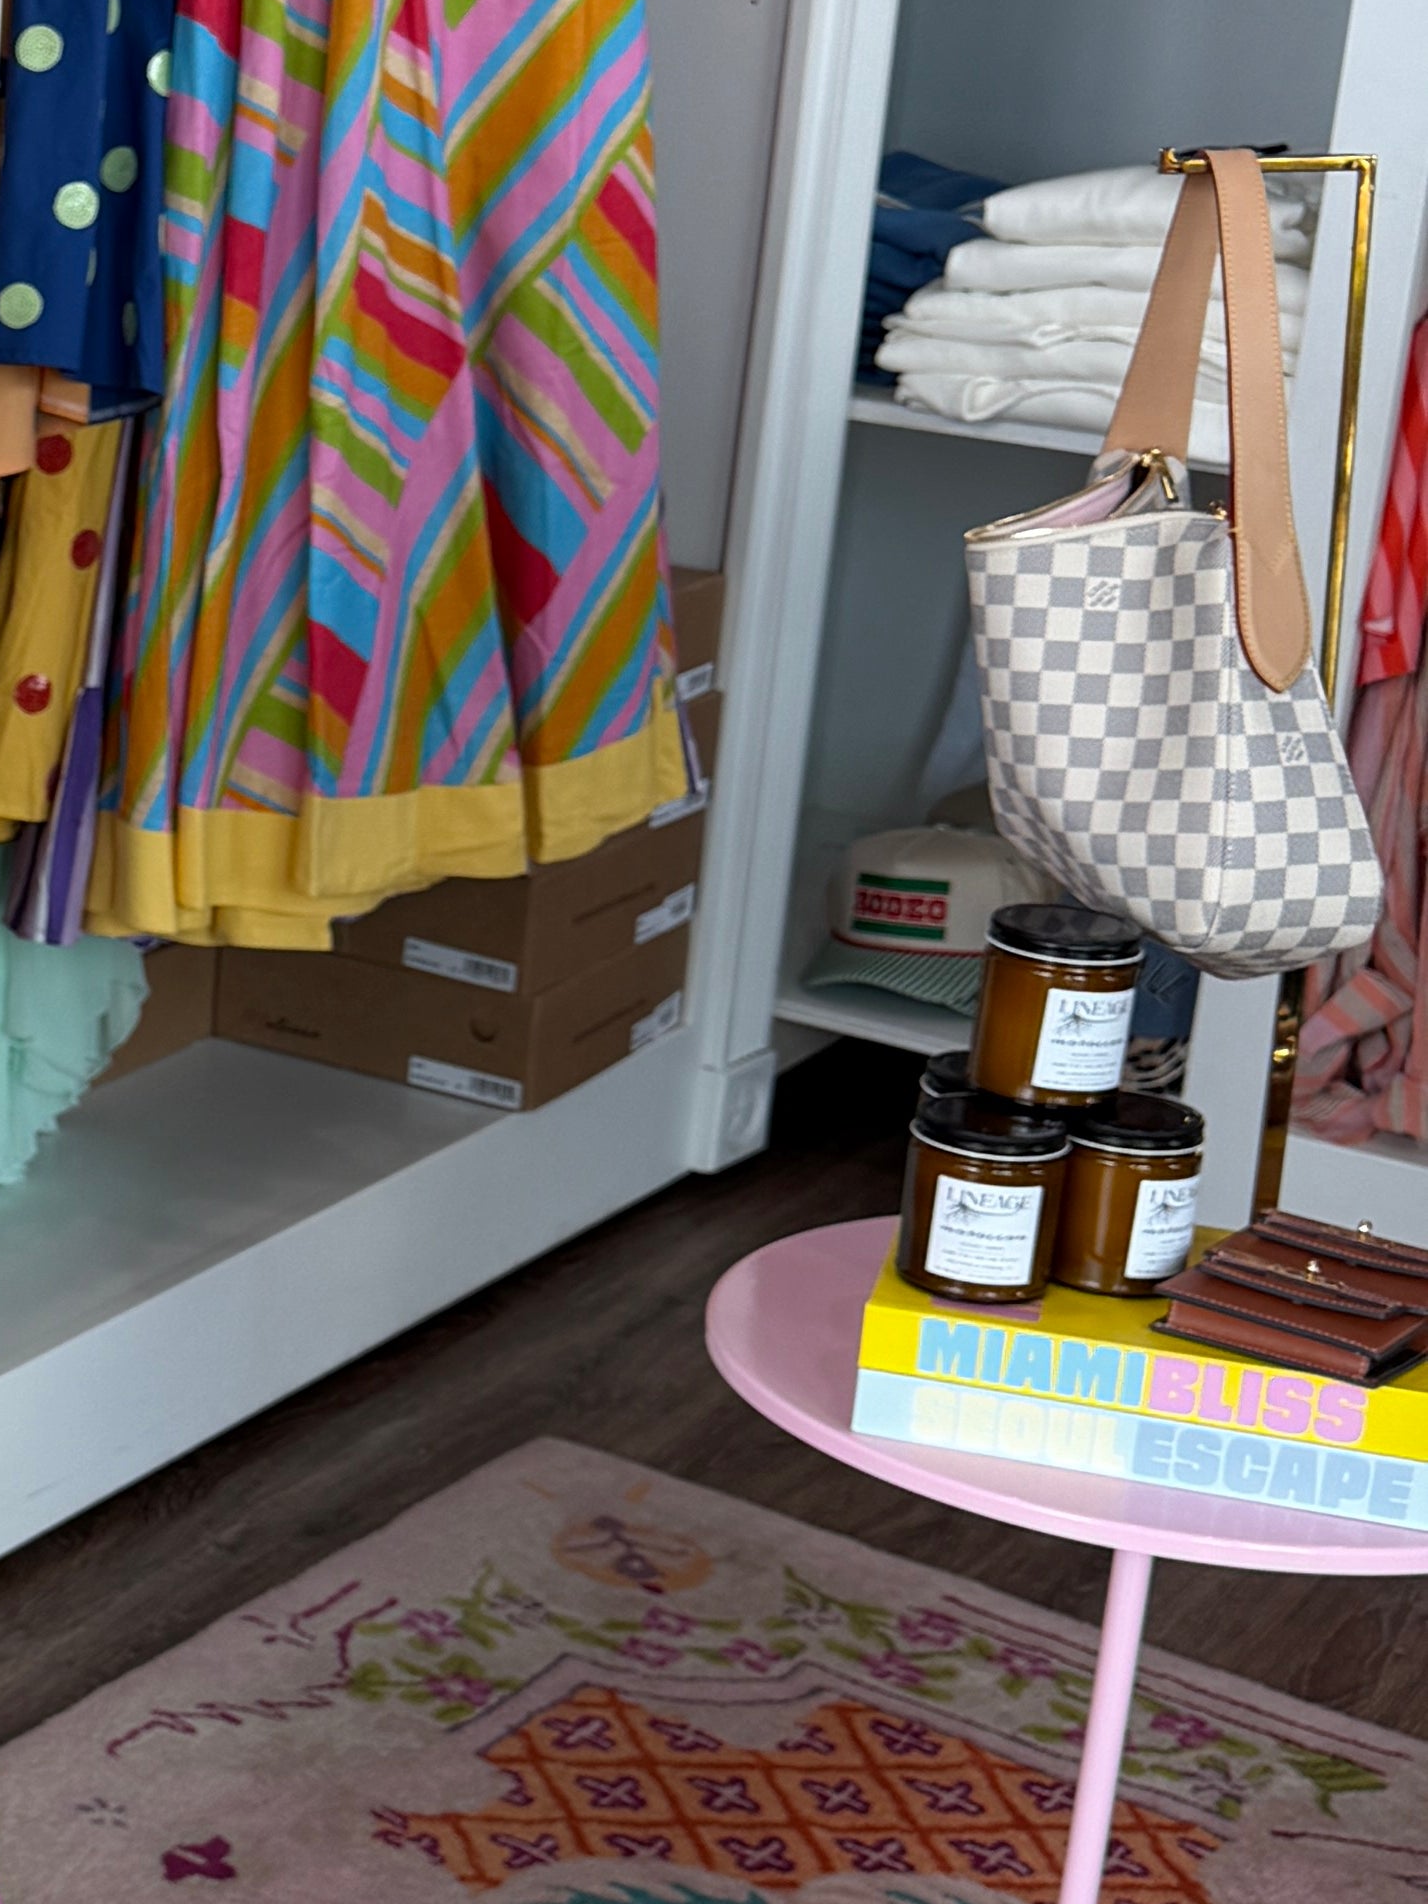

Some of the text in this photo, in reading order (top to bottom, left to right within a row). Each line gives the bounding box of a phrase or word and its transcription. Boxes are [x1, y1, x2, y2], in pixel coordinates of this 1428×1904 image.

[946, 1186, 1033, 1211] LINEAGE
[918, 1318, 1369, 1445] MIAMI BLISS
[912, 1386, 1416, 1523] SEOUL ESCAPE
